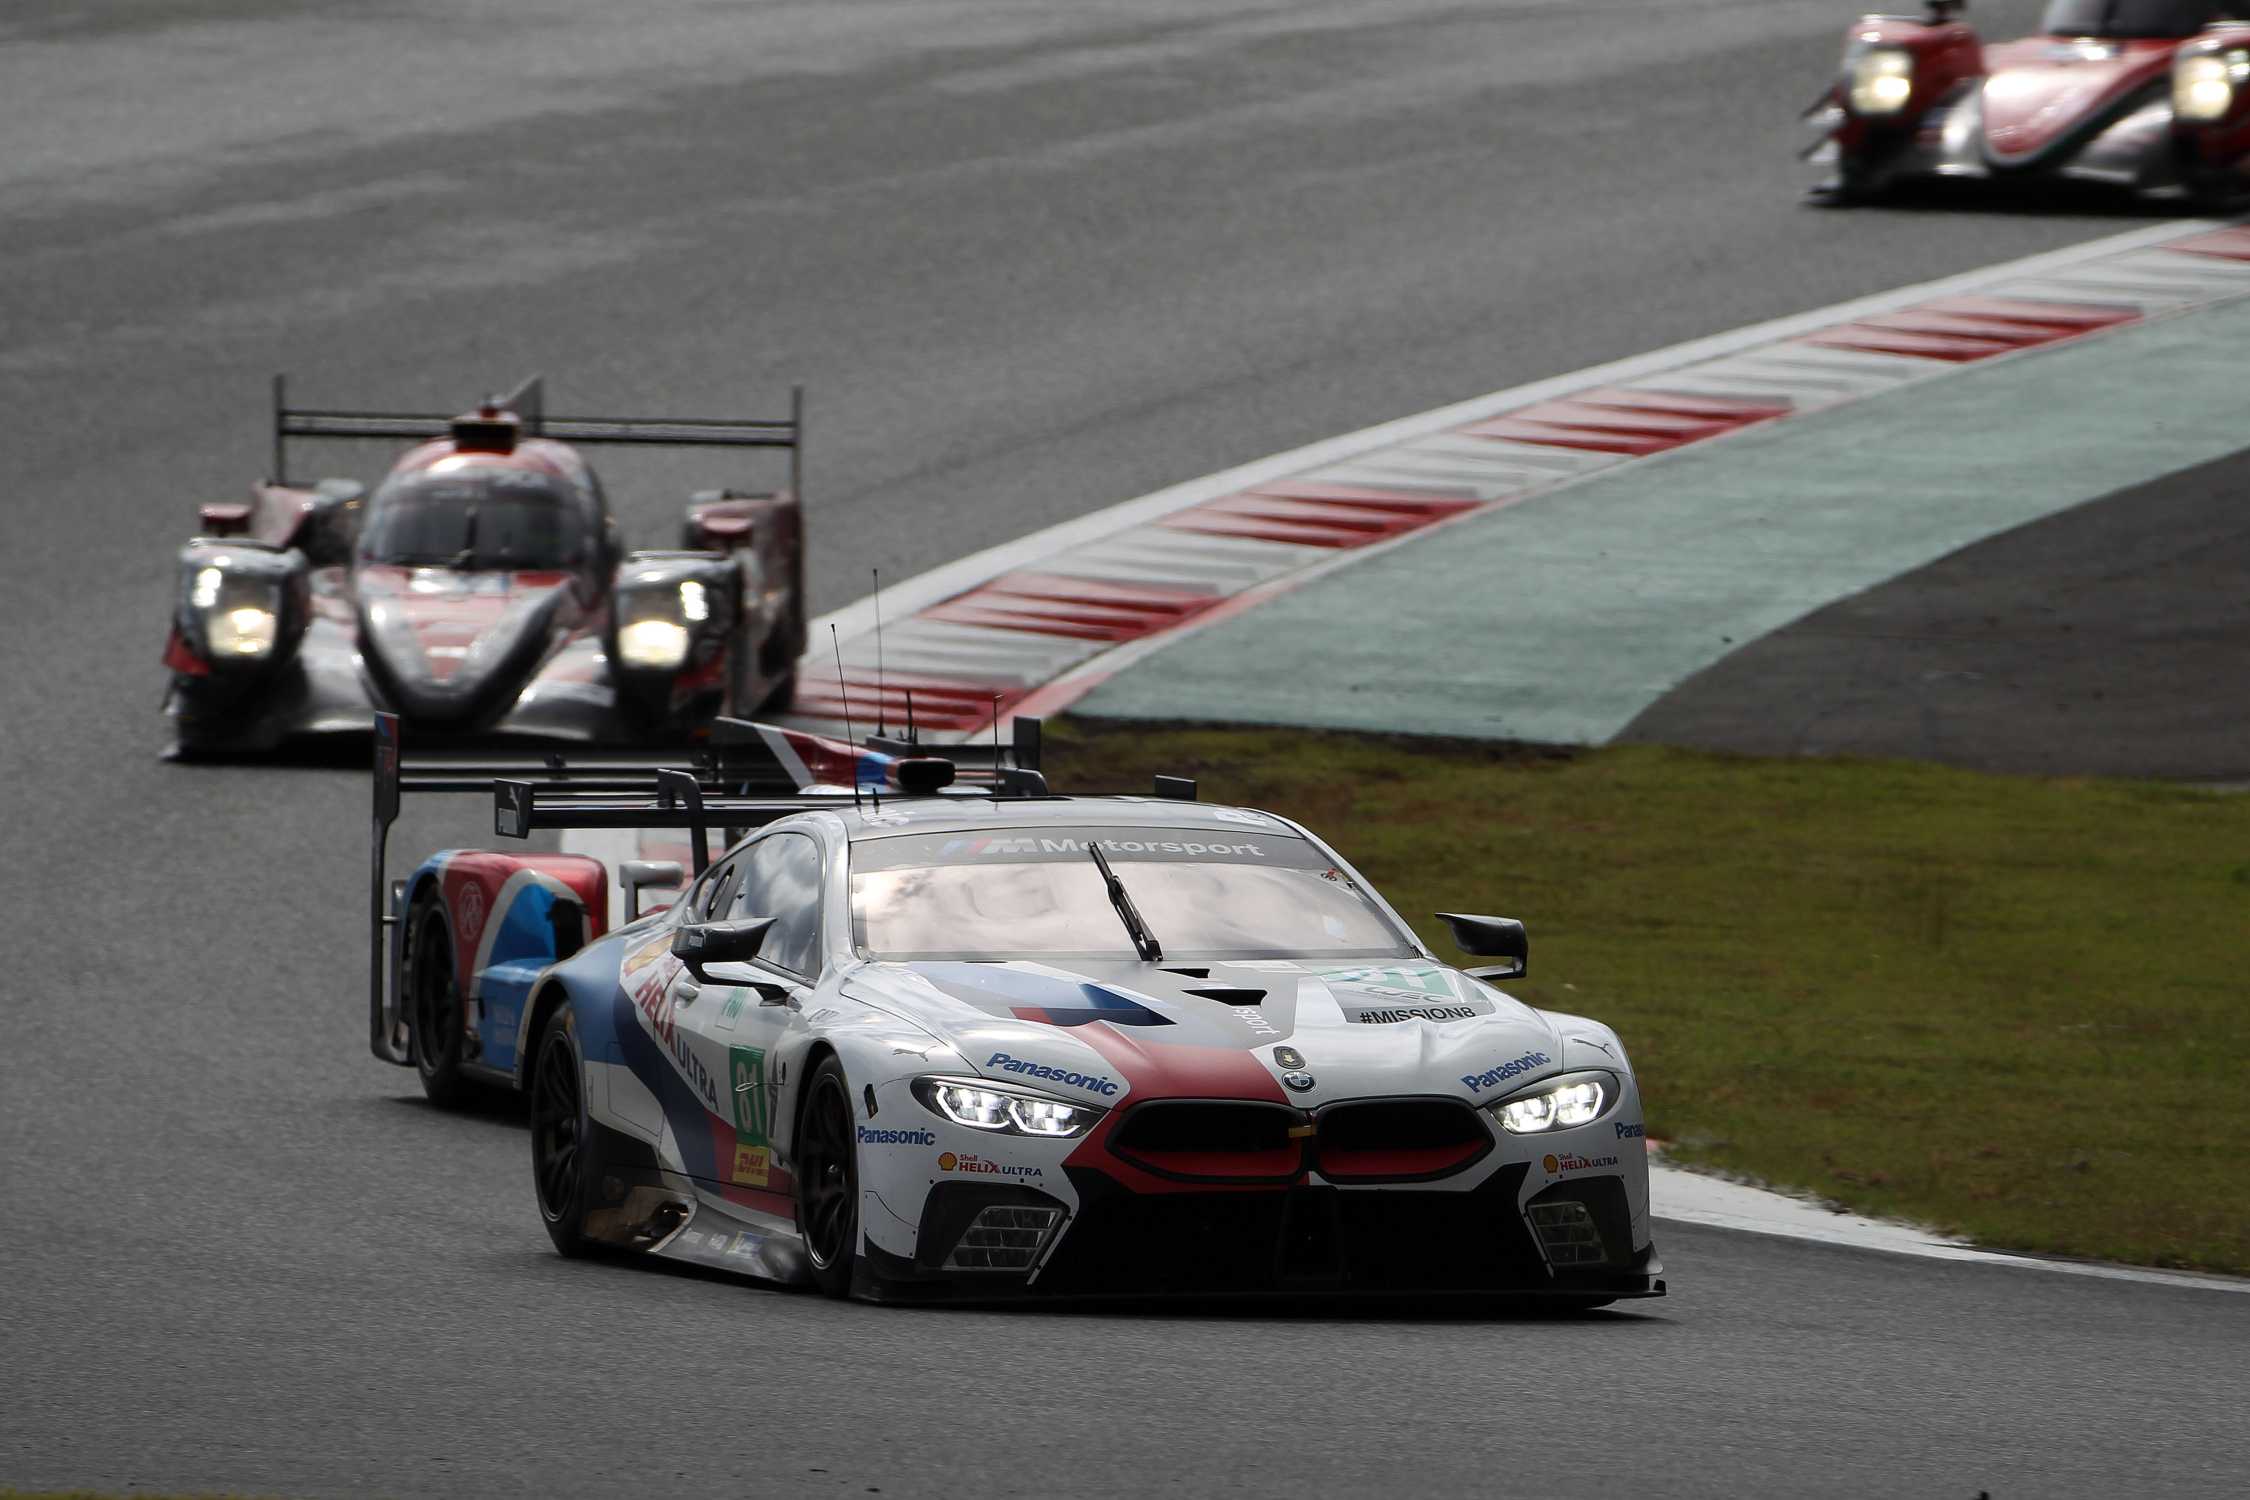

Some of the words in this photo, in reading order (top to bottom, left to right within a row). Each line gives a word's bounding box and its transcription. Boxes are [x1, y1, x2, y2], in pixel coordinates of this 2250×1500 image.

[1040, 838, 1265, 857] Motorsport
[676, 1032, 720, 1113] ULTRA
[986, 1053, 1118, 1097] Panasonic
[1461, 1051, 1551, 1094] Panasonic
[857, 1126, 936, 1146] Panasonic
[959, 1153, 978, 1163] Shell
[1560, 1160, 1592, 1171] HELIX
[1592, 1156, 1619, 1168] ULTRA
[959, 1162, 1001, 1175] HELIX
[1002, 1166, 1043, 1177] ULTRA
